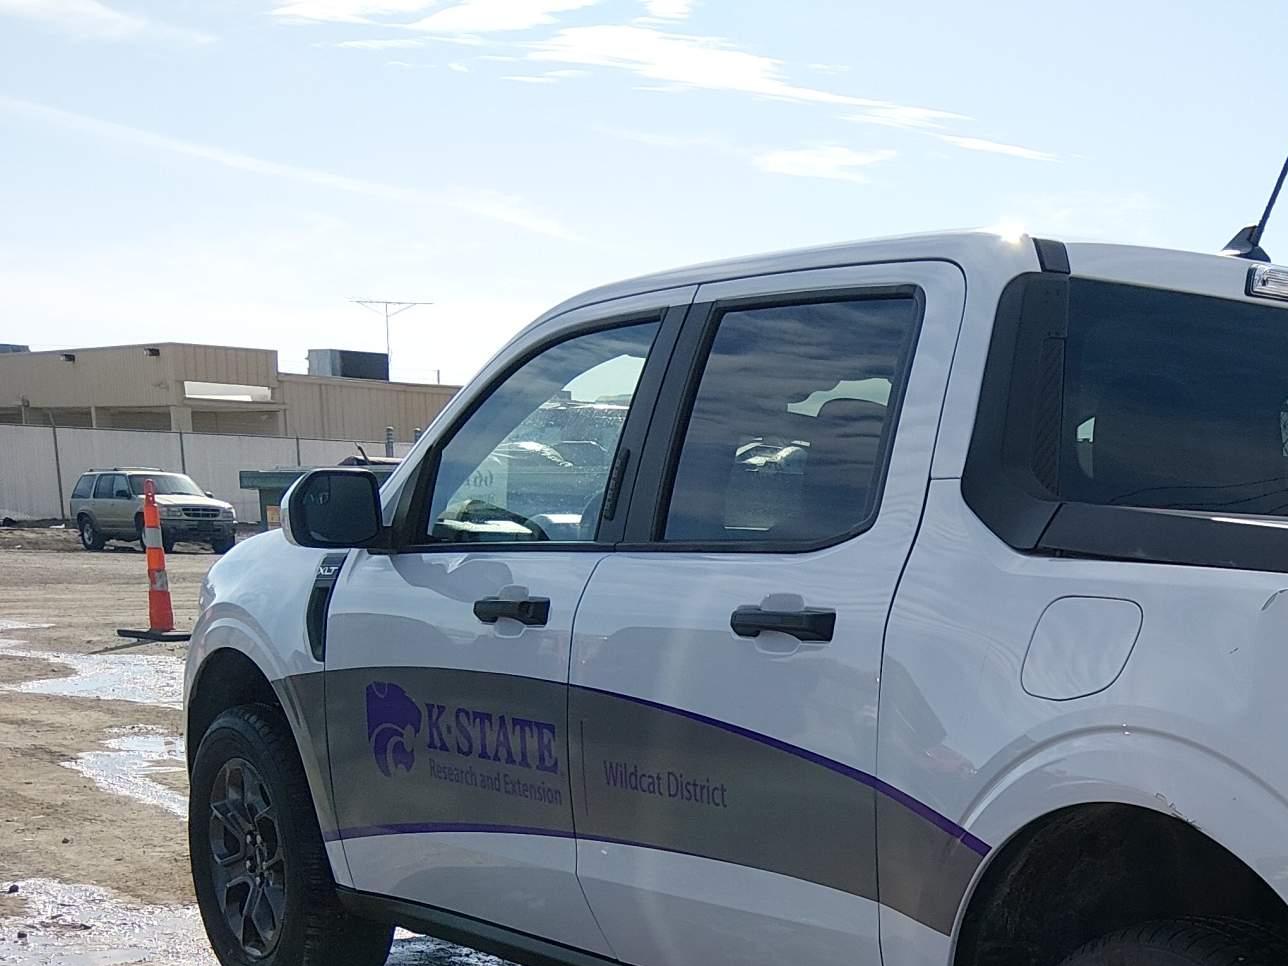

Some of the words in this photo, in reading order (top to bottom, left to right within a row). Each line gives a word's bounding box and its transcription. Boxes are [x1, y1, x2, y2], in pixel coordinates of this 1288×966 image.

[319, 565, 339, 576] XLT
[428, 758, 478, 787] Research
[479, 772, 501, 793] and
[503, 774, 562, 806] Extension
[603, 760, 662, 796] Wildcat
[666, 771, 728, 808] District
